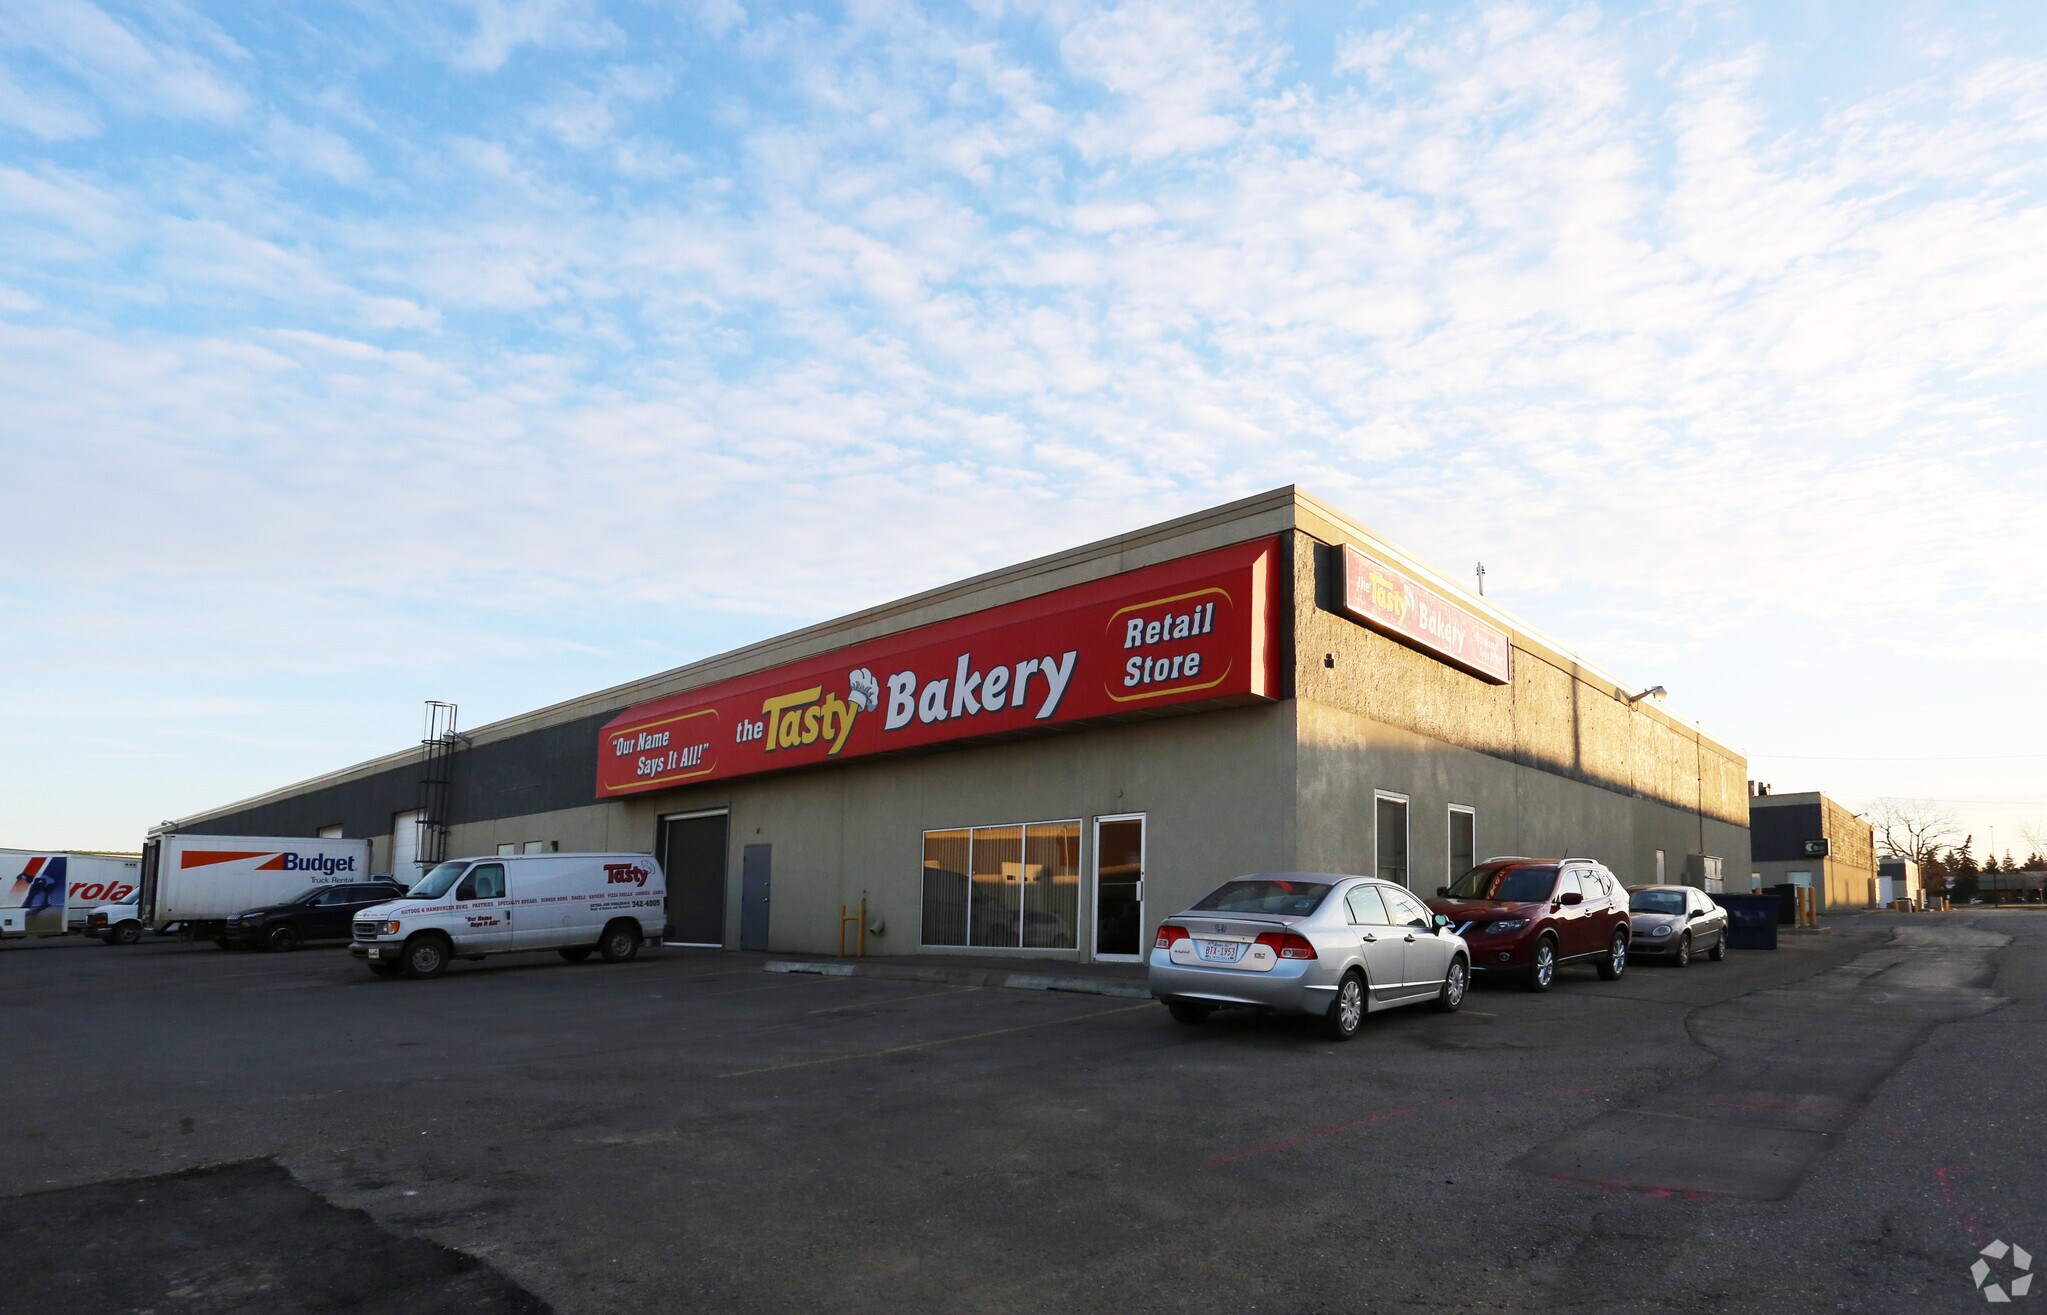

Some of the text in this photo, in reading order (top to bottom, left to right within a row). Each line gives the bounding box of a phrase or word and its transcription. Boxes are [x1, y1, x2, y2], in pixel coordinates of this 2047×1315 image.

[1124, 602, 1214, 649] Retail
[1357, 575, 1370, 593] the
[1369, 571, 1408, 625] Tasty
[1419, 602, 1465, 653] Bakery
[1123, 652, 1201, 687] Store
[735, 650, 1078, 755] the Tasty Bakery
[637, 730, 670, 751] Name
[636, 755, 664, 777] Says
[667, 750, 677, 769] It
[284, 852, 355, 876] Budget
[603, 863, 649, 887] Tasty
